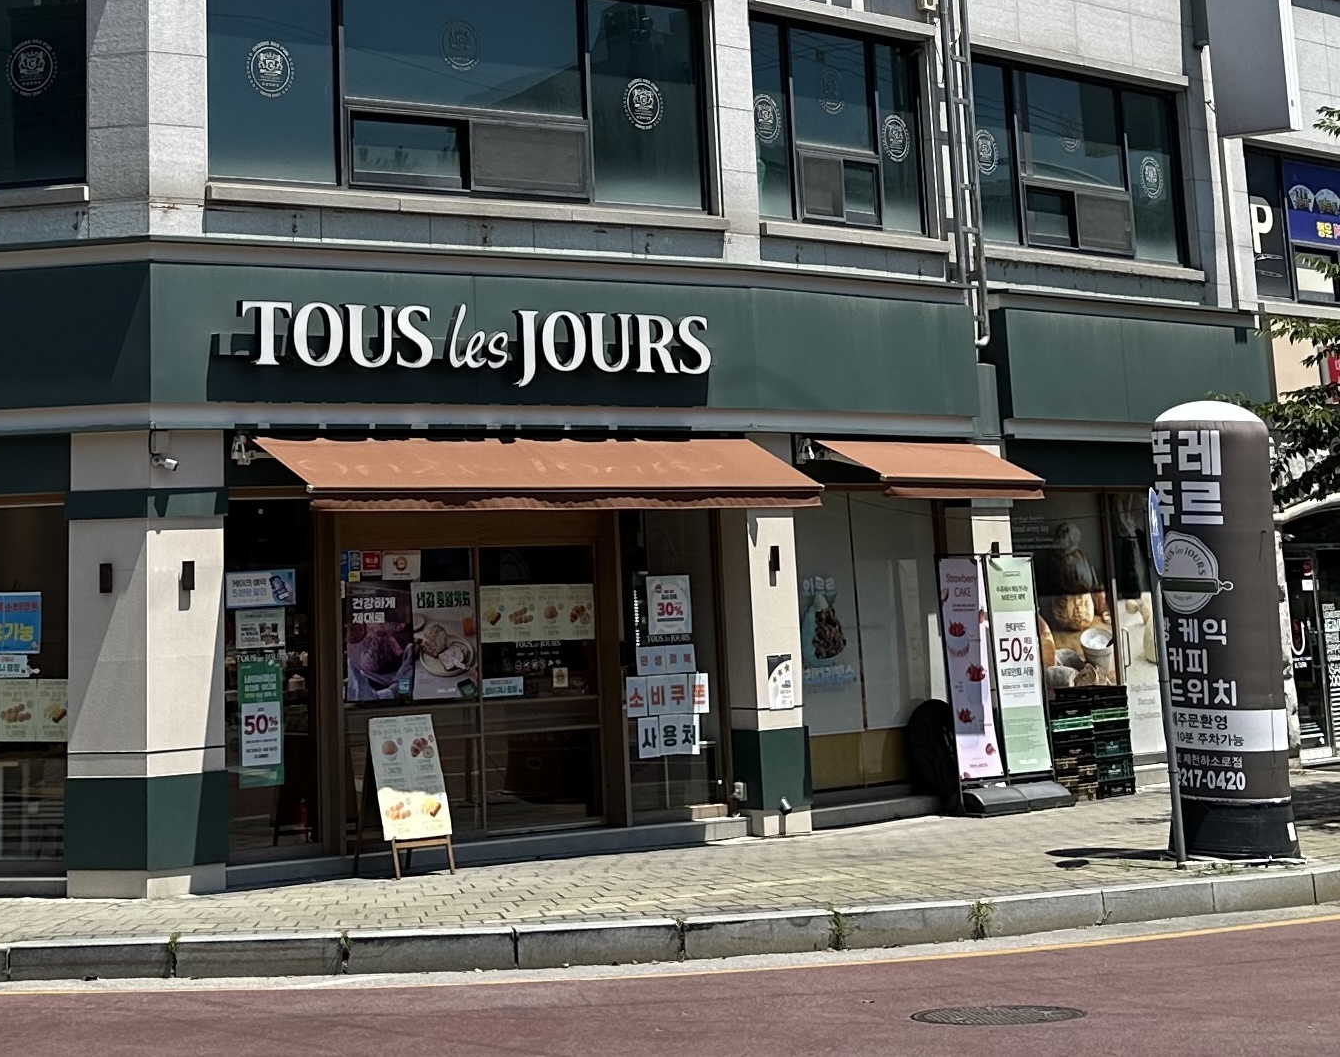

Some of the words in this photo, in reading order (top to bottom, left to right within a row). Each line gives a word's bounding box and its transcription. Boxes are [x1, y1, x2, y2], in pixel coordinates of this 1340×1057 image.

[241, 299, 434, 369] TOUS
[448, 303, 509, 369] les
[513, 309, 713, 387] JOURS
[953, 586, 971, 598] CAKE
[352, 597, 396, 610] 건강하게
[657, 602, 683, 616] 30%
[352, 611, 386, 624] 제대로
[1005, 622, 1026, 632] 현대카드
[1178, 618, 1227, 646] 케익
[999, 637, 1034, 663] 50%
[1169, 647, 1208, 675] 커피
[630, 684, 706, 708] 소비쿠폰
[244, 714, 278, 736] 50%
[642, 724, 696, 749] 사용처
[1198, 733, 1244, 747] 주차가능
